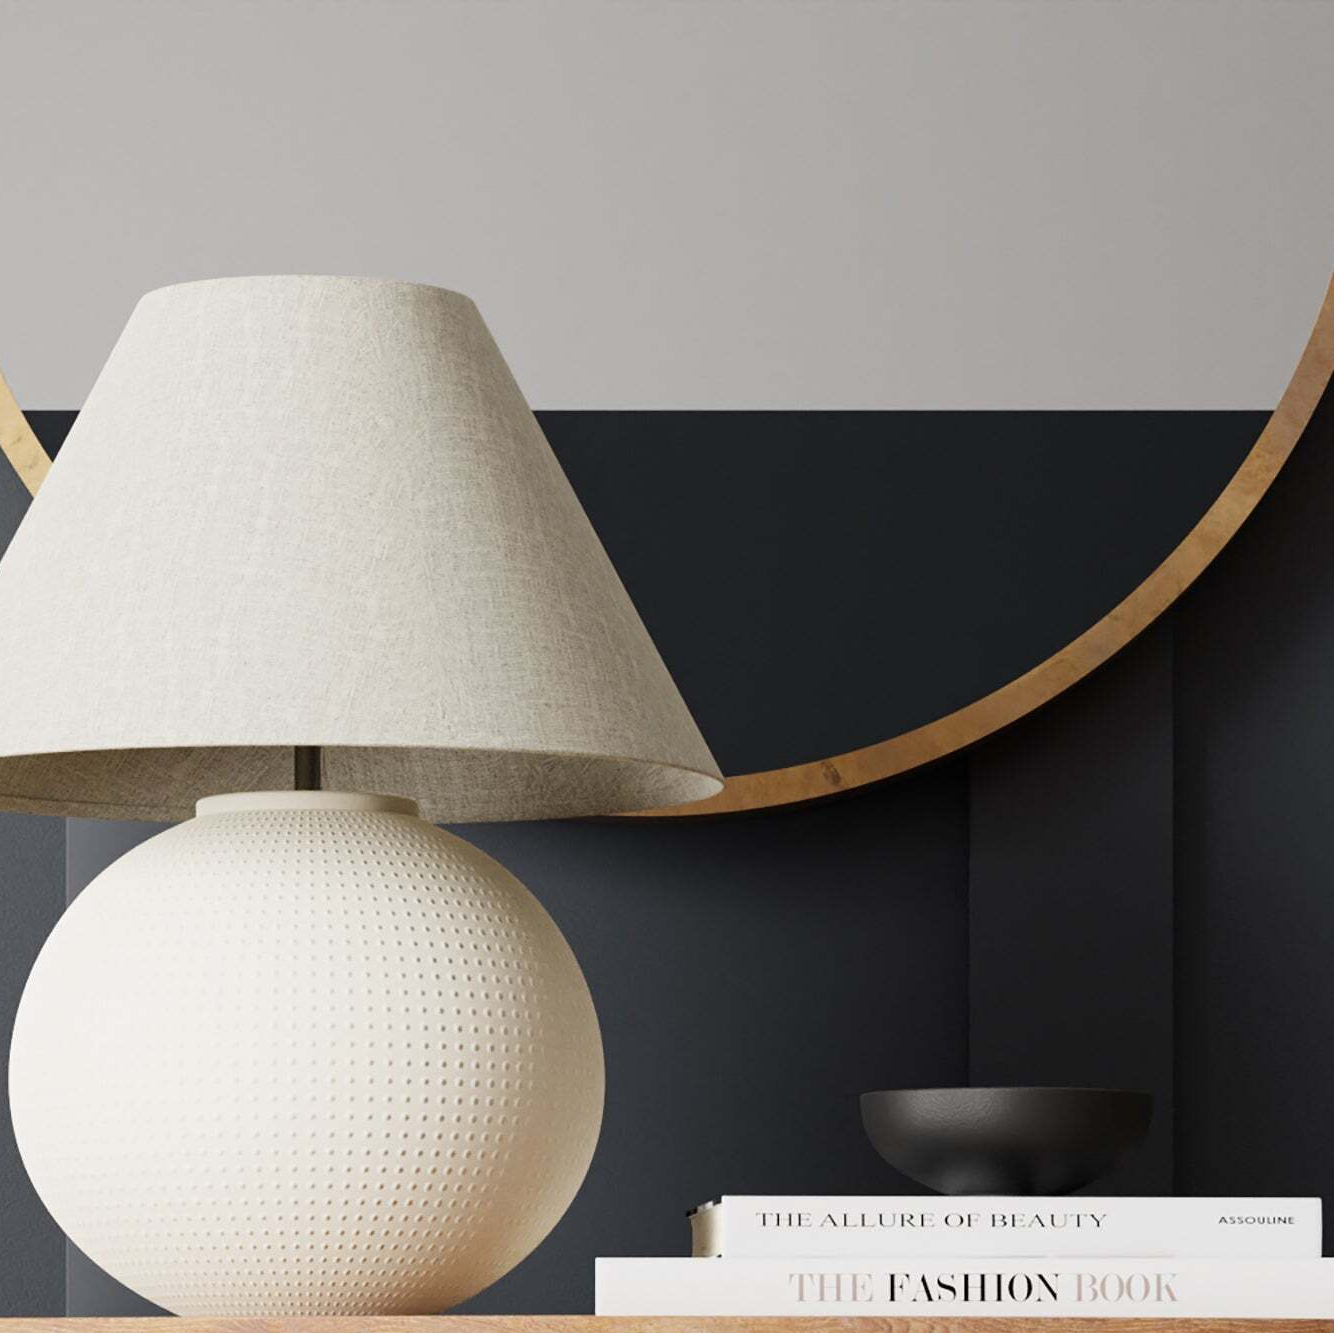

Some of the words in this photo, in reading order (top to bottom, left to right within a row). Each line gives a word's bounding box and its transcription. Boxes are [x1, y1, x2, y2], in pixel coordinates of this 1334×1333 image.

[755, 1211, 814, 1229] THE
[819, 1211, 936, 1229] ALLURE
[944, 1211, 982, 1229] OF
[990, 1211, 1108, 1229] BEAUTY
[1218, 1215, 1296, 1226] ASSOULINE
[788, 1272, 874, 1303] THE
[887, 1272, 1060, 1303] FASHION
[1075, 1272, 1179, 1303] BOOK
